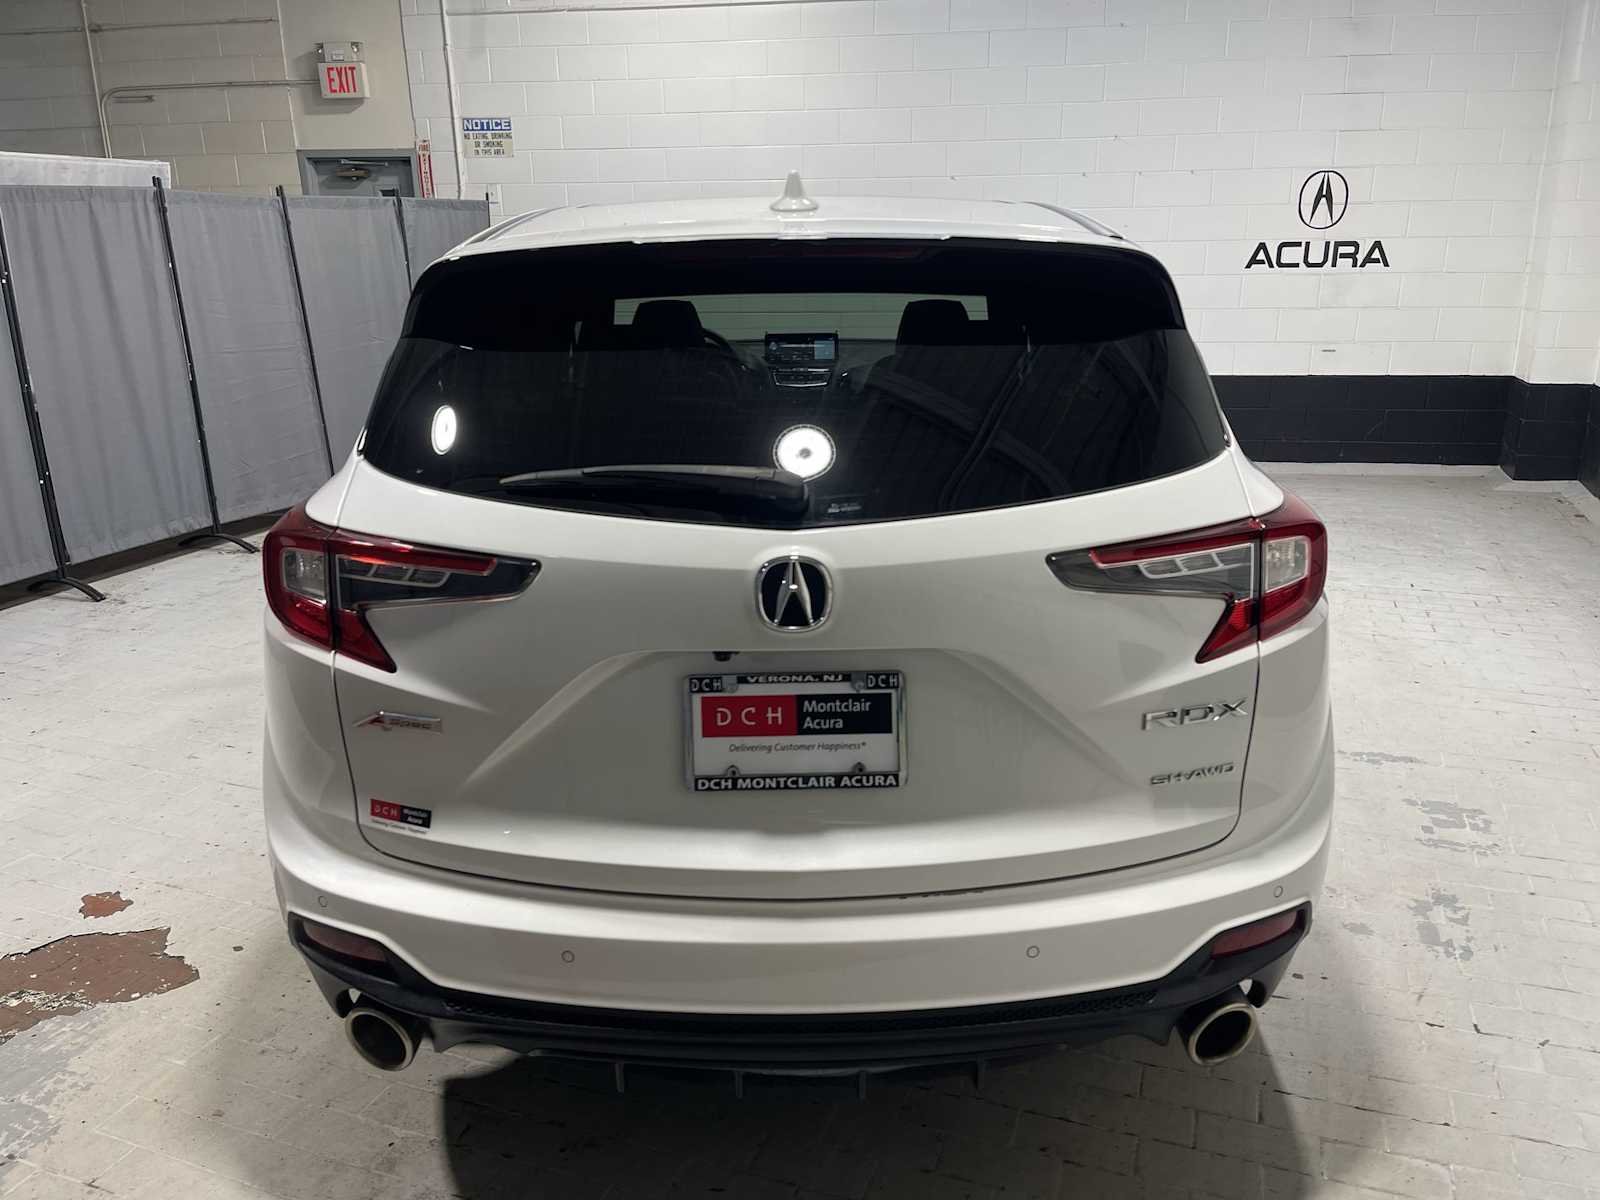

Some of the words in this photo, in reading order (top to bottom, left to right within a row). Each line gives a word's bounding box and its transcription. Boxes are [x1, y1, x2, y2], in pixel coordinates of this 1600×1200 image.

[327, 66, 357, 94] EXIT
[463, 119, 511, 130] NOTICE
[1245, 240, 1390, 269] ACURA
[690, 678, 723, 692] DCH
[823, 673, 844, 683] NJ
[867, 675, 900, 689] DCH
[803, 698, 872, 714] Montclair
[1141, 696, 1248, 731] RDX
[803, 716, 844, 730] Acura
[729, 742, 773, 754] Delivering
[774, 741, 816, 752] Customer
[697, 777, 733, 791] DCH
[736, 776, 836, 790] MONTCLAIR
[839, 774, 898, 788] ACURA
